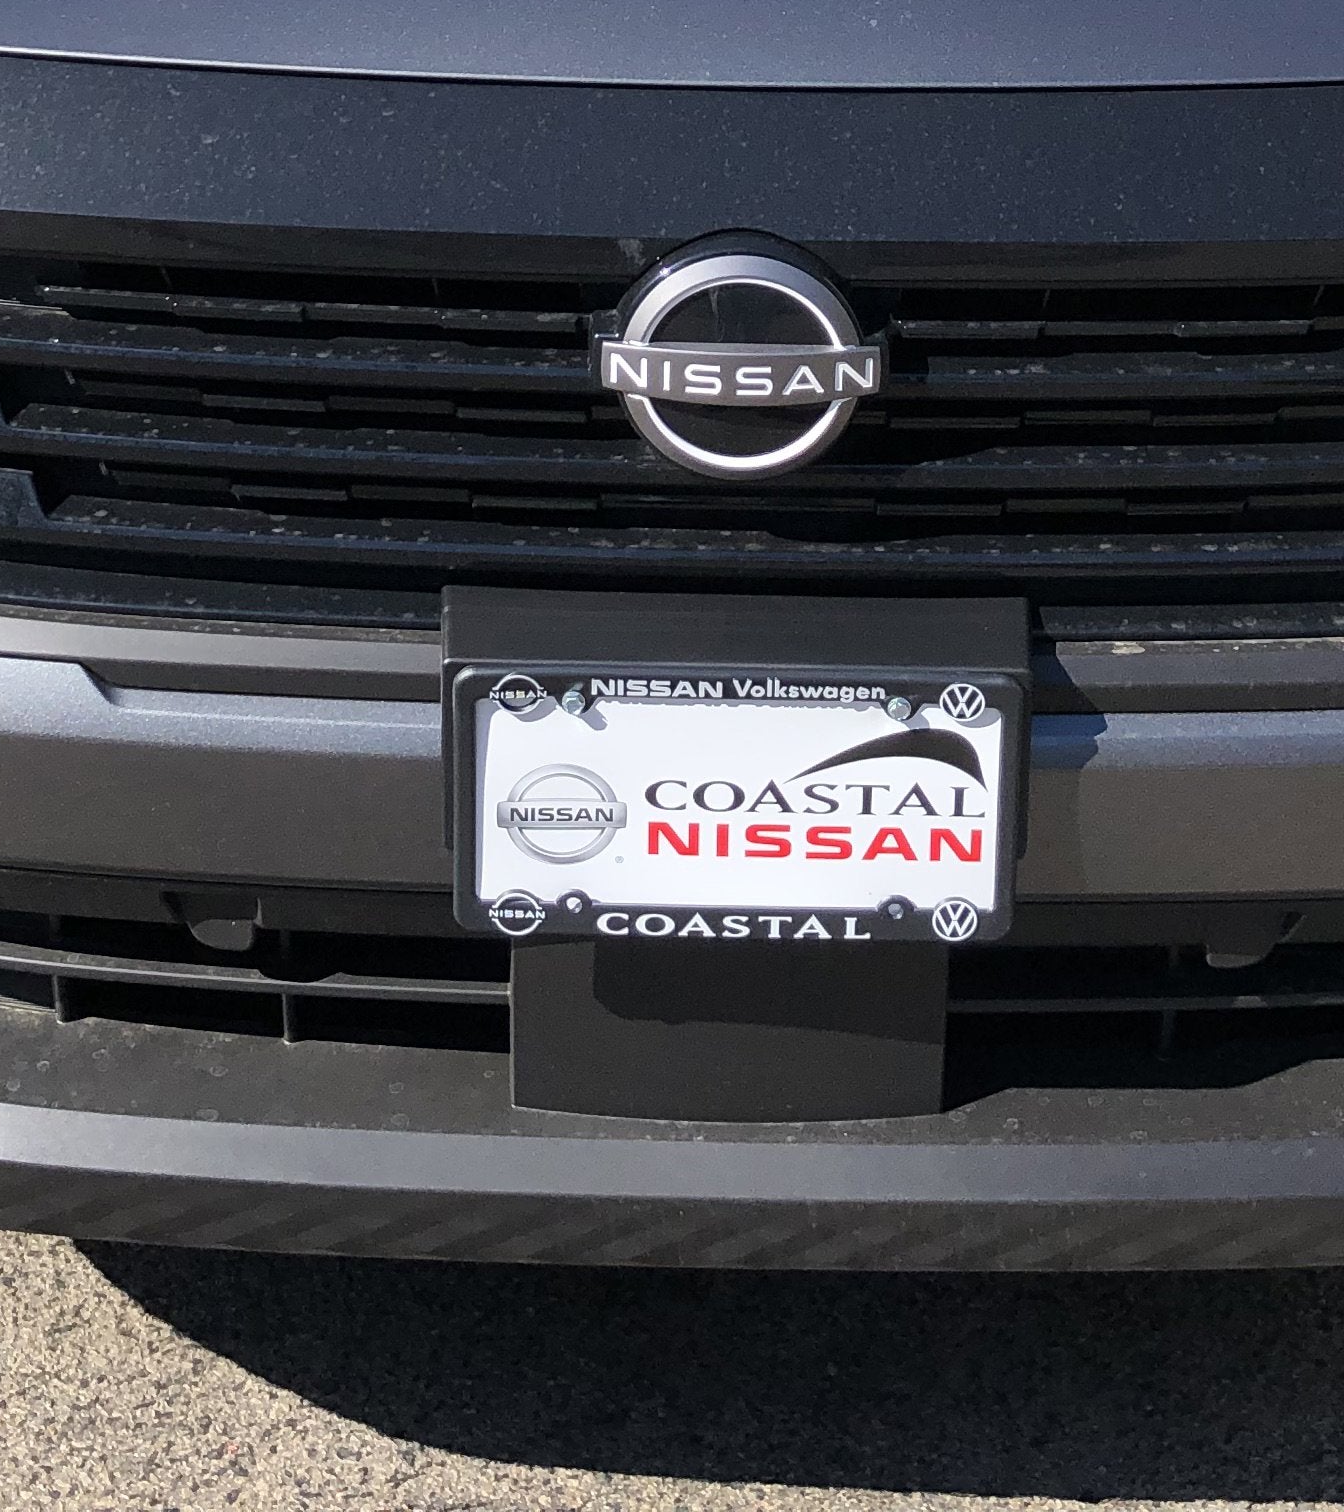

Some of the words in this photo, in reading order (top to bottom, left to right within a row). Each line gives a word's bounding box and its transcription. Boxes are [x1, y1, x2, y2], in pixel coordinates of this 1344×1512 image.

[609, 352, 874, 396] NISSAN
[489, 689, 547, 700] NISSAN
[590, 678, 723, 699] NISSAN
[732, 678, 886, 702] Volkswagen
[644, 779, 986, 818] COASTAL
[510, 806, 613, 823] NISSAN
[647, 821, 983, 862] NISSAN
[489, 907, 545, 920] NISSAN
[596, 912, 871, 940] COASTAL
